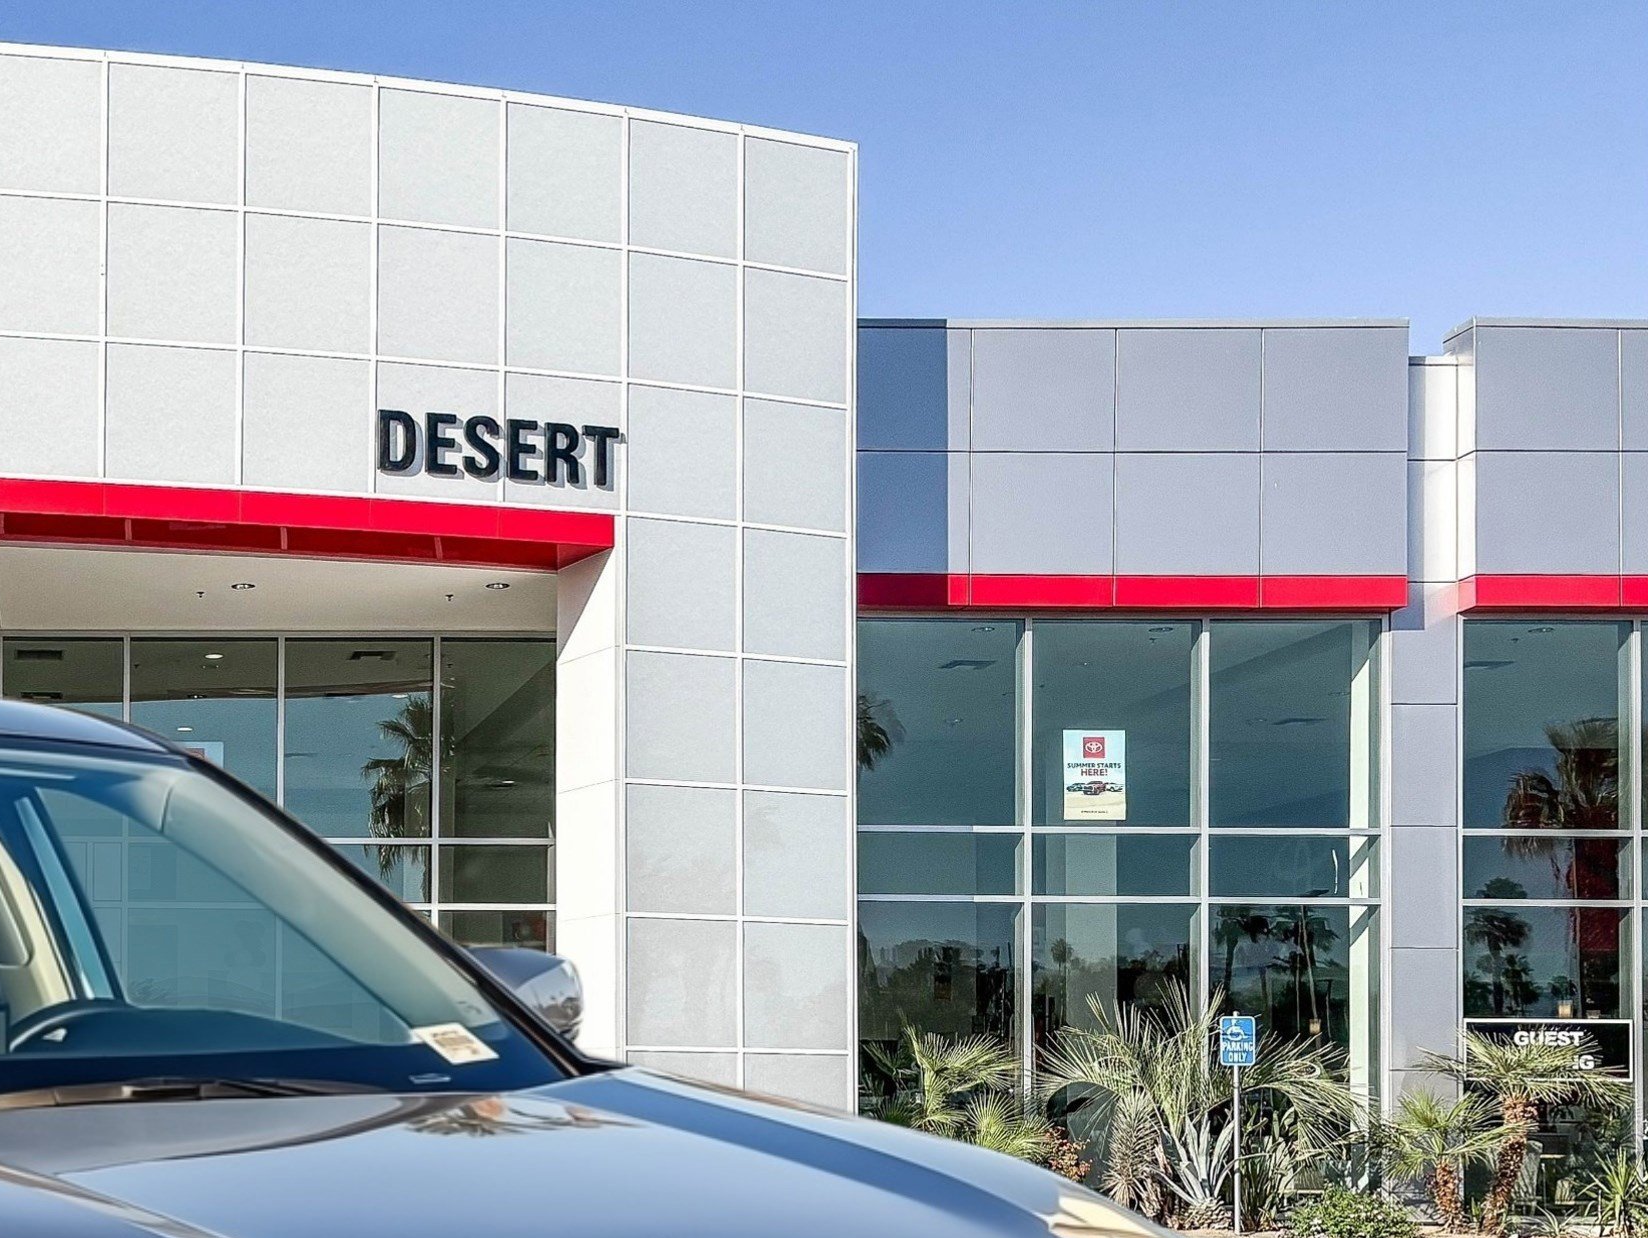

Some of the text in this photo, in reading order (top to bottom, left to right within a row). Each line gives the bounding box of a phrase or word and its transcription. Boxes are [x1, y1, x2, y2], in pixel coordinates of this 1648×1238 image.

[377, 409, 620, 487] DESERT
[1514, 1031, 1585, 1046] GUEST
[1222, 1042, 1253, 1051] PARKING
[1228, 1052, 1247, 1062] ONLY
